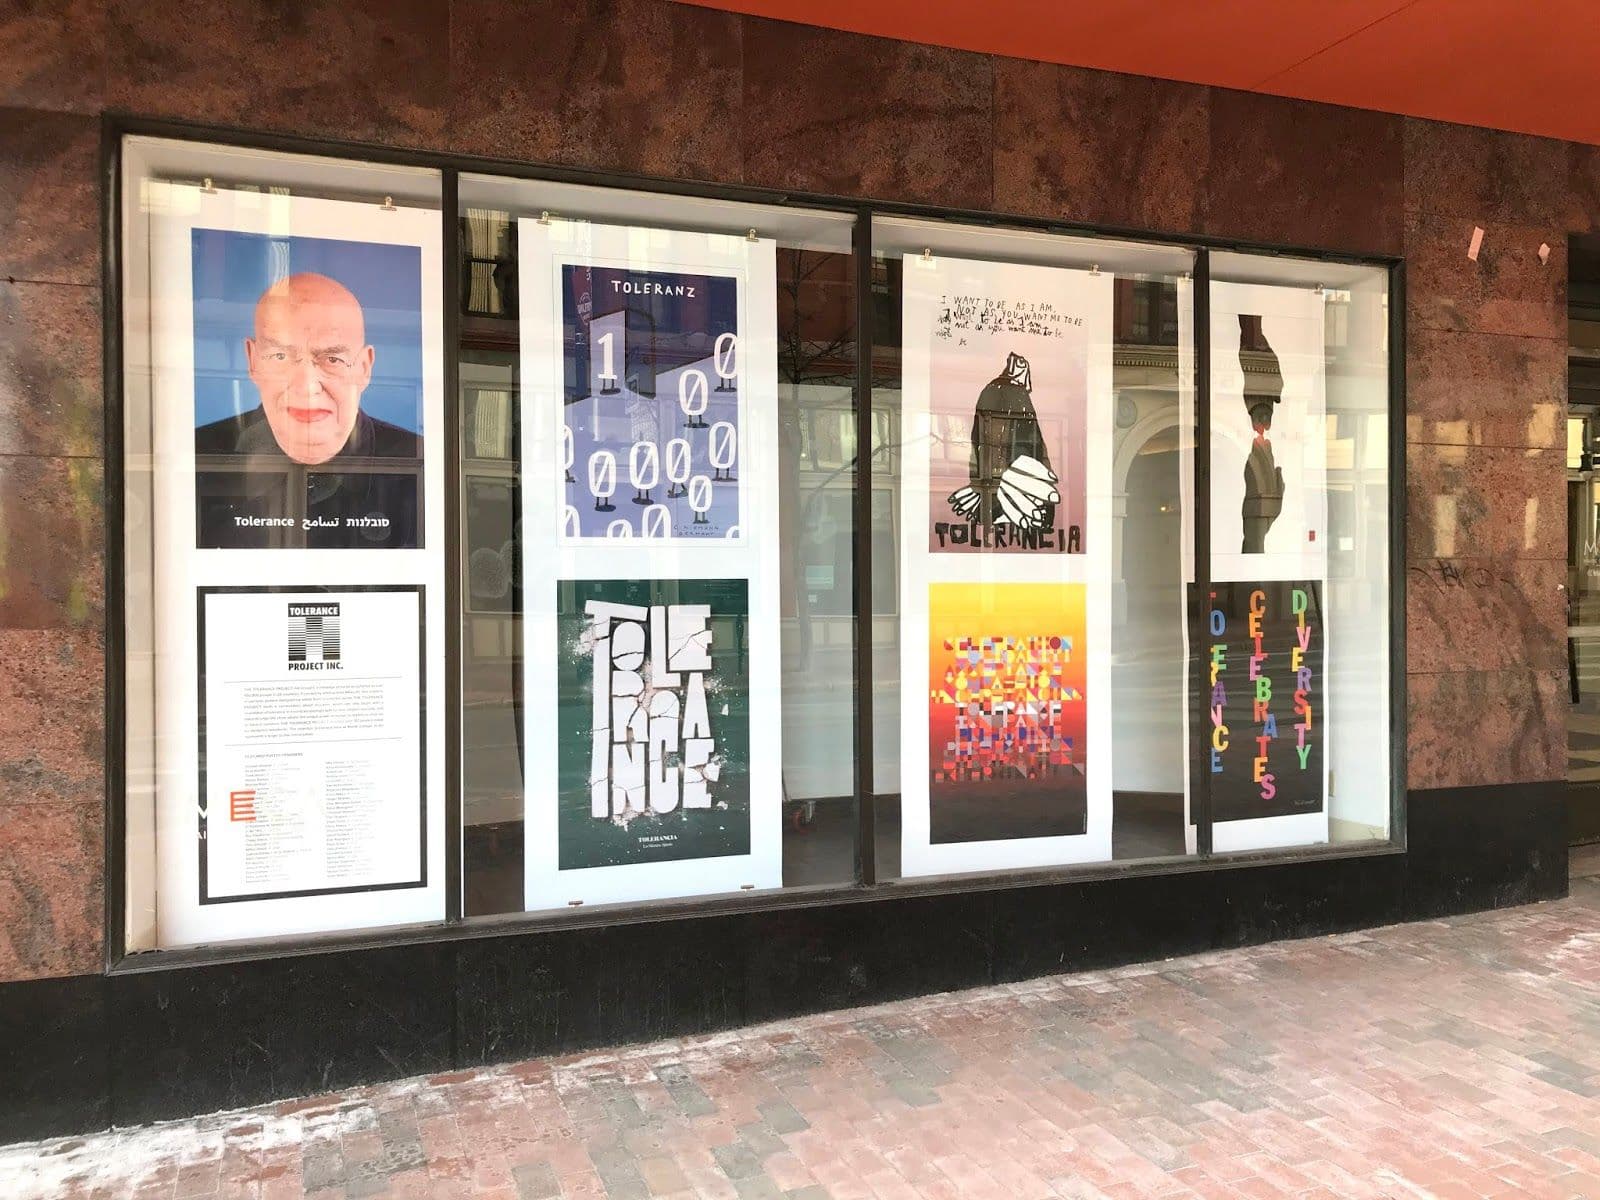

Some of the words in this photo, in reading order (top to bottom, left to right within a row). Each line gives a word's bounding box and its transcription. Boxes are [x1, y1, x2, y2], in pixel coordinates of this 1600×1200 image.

[611, 280, 696, 298] TOLERANZ
[953, 295, 981, 305] WANT
[985, 298, 994, 308] TO
[1015, 302, 1026, 311] AS
[957, 304, 976, 315] NOT
[1001, 309, 1019, 320] YOU
[1024, 312, 1048, 321] WANT
[1064, 315, 1073, 324] TO
[234, 516, 295, 527] Tolerance
[302, 516, 340, 531] تسامح
[346, 516, 390, 528] סובלנות
[935, 522, 1081, 554] TOLERANCIA
[289, 606, 340, 616] TOLERANCE
[288, 662, 324, 671] PROJECT
[326, 661, 344, 670] INC.
[1292, 589, 1313, 770] DIVERSITY
[1249, 590, 1279, 800] CELEBRATES
